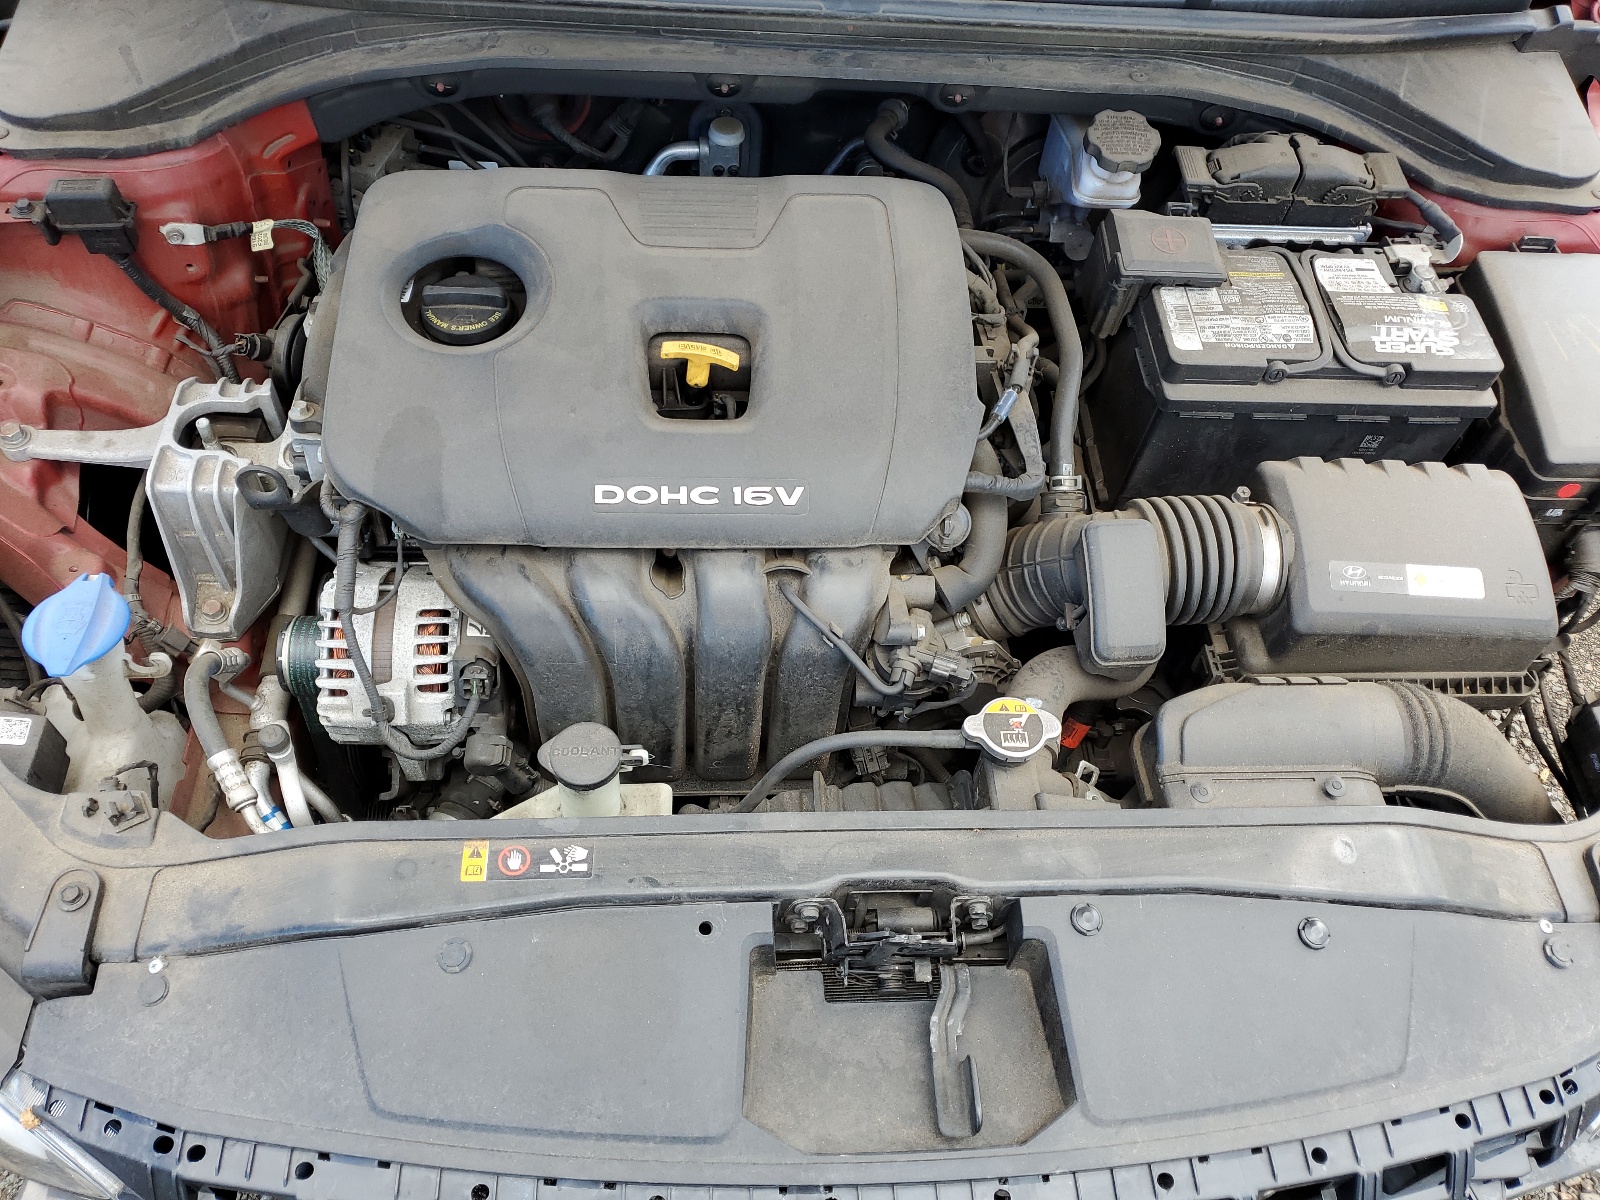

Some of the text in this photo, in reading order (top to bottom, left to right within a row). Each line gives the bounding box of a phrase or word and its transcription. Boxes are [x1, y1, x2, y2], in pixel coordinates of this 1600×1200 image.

[425, 309, 502, 331] SEE OWNER'S MANUAL
[1372, 326, 1460, 345] START
[1375, 340, 1456, 356] SUPER
[594, 484, 805, 506] DOHC 16V
[1340, 579, 1371, 588] HYUNDAI
[551, 746, 620, 757] COOLANT
